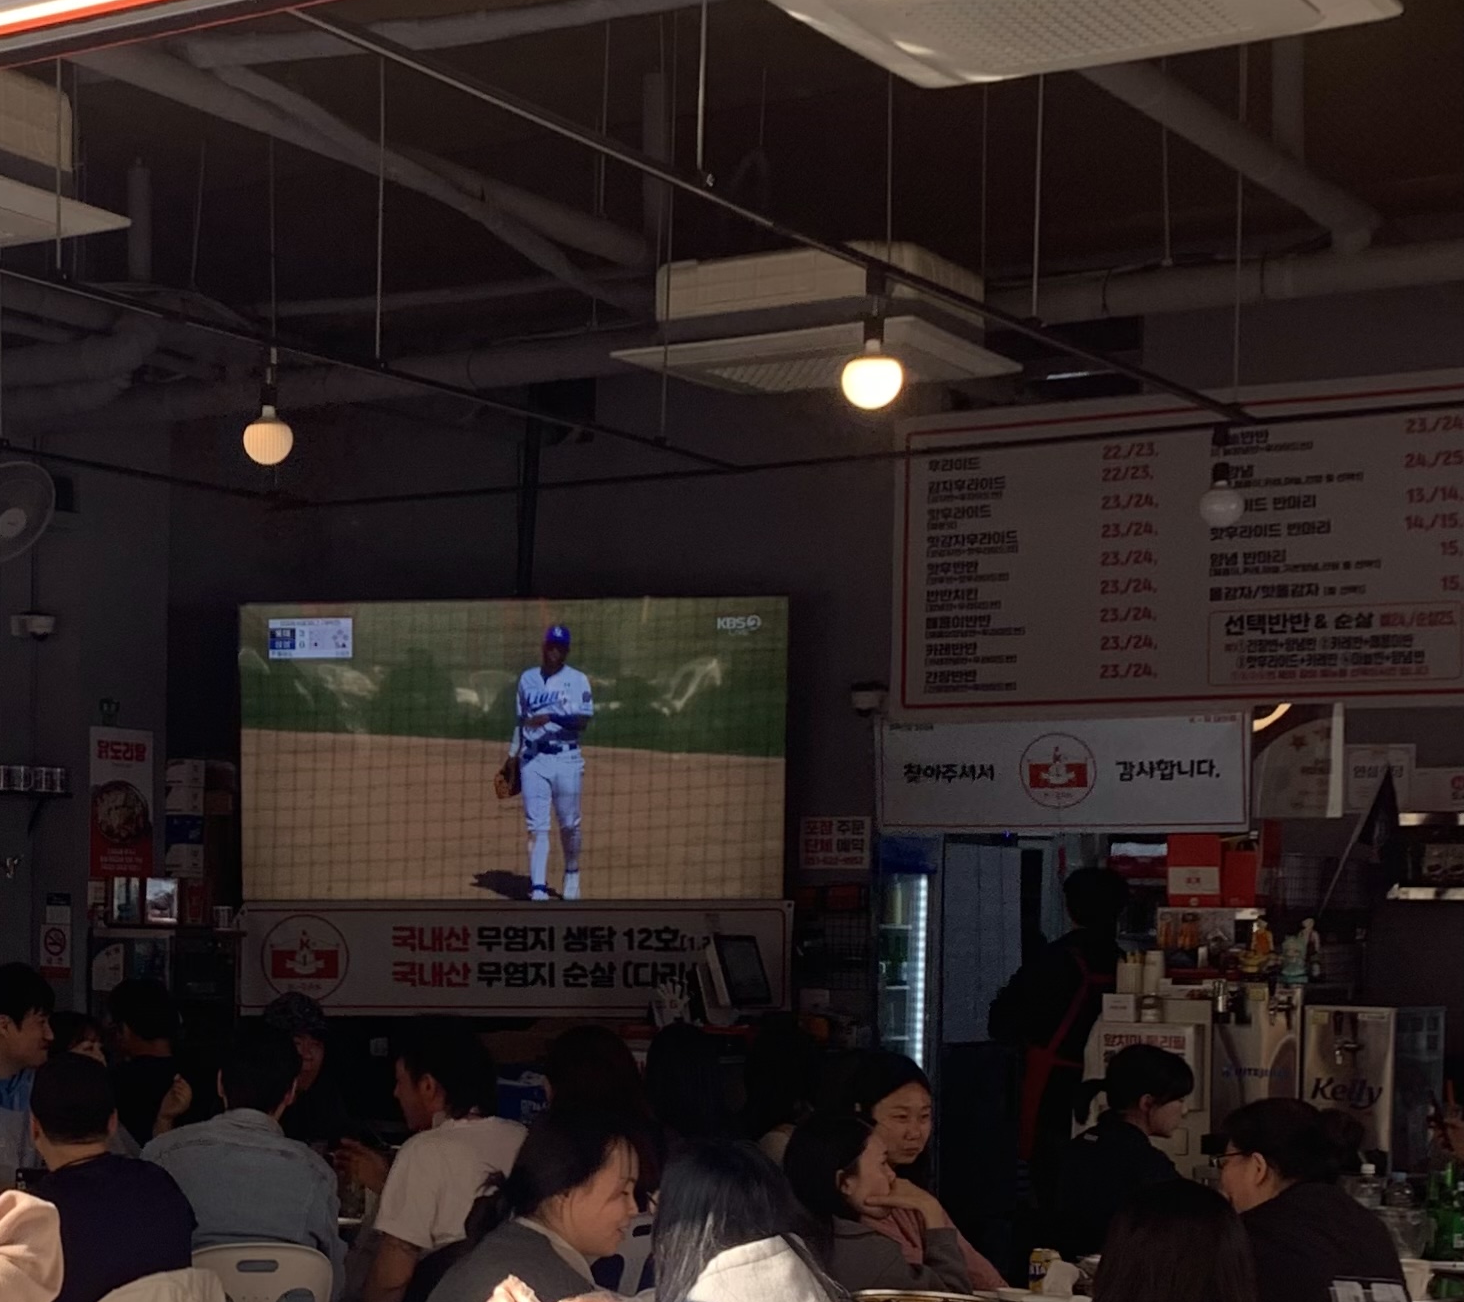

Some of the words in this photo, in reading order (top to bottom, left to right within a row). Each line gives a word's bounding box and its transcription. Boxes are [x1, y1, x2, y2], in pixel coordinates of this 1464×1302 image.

[1224, 612, 1311, 636] 선택반반
[1334, 612, 1374, 630] 순살
[903, 763, 995, 785] 찾아주셔서
[1115, 758, 1221, 781] 감사합니다.
[391, 926, 471, 953] 국내산
[477, 926, 556, 953] 무염지
[562, 926, 617, 953] 생닭
[391, 962, 471, 989] 국내산
[477, 962, 556, 989] 무염지
[562, 962, 617, 989] 순살
[1310, 1077, 1384, 1110] Kelly
